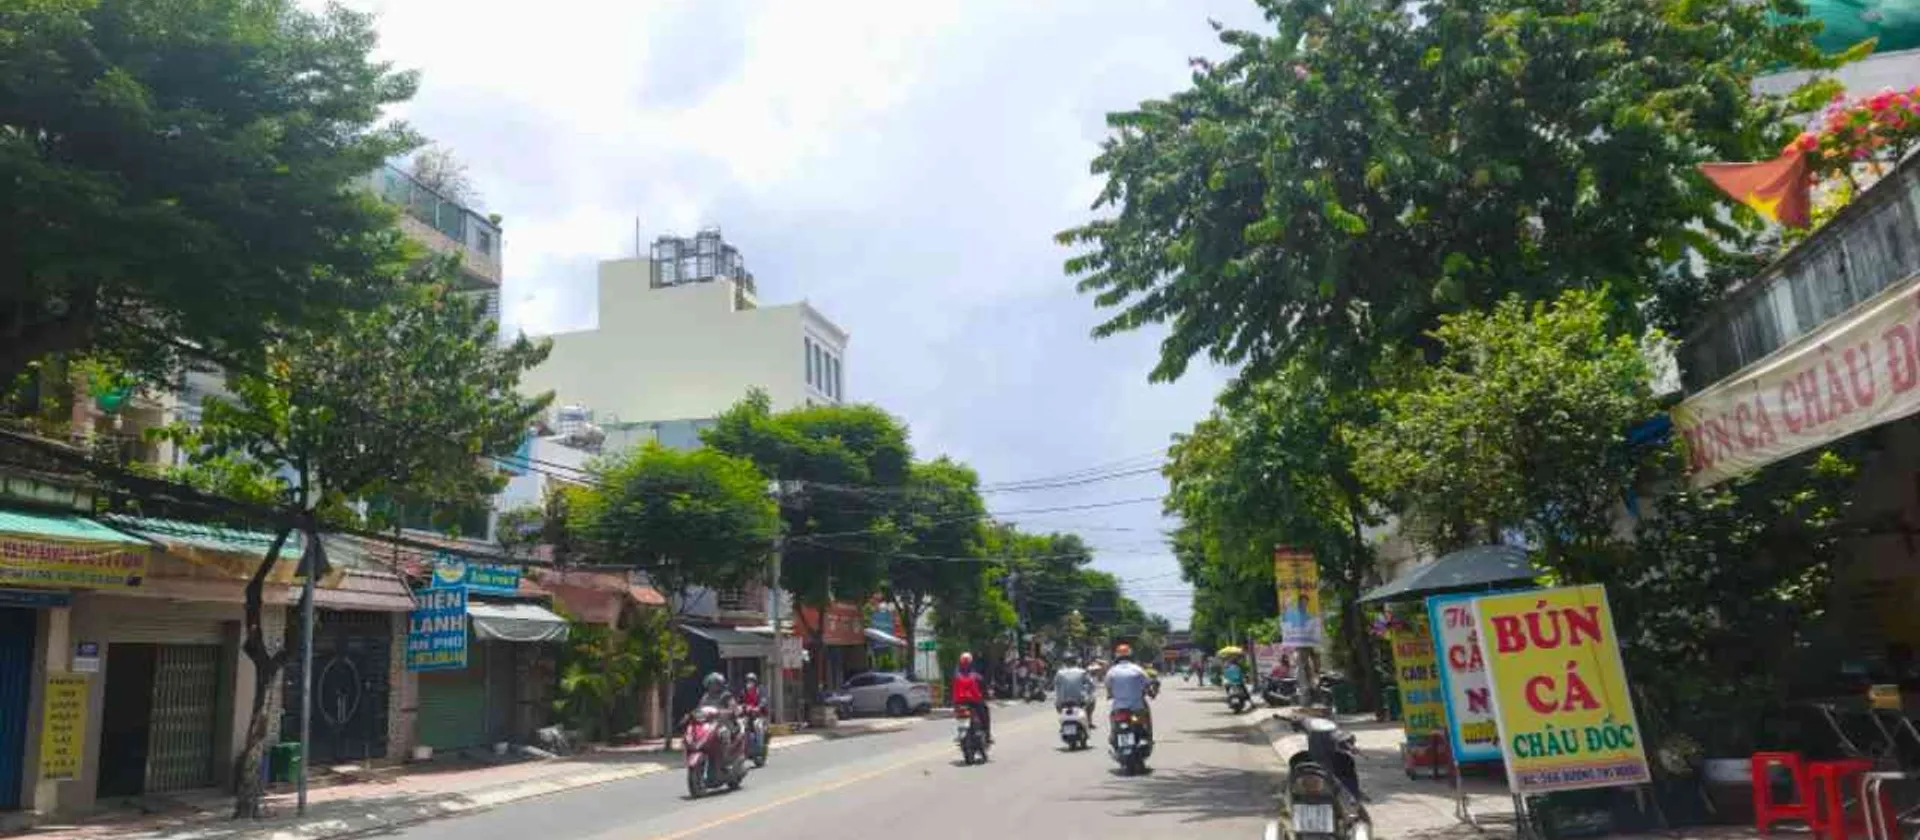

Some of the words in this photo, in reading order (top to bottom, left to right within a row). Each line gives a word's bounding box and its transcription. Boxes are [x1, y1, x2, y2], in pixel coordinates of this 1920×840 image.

[1779, 344, 1875, 433] CHÂU
[1491, 599, 1603, 654] BÚN
[1525, 660, 1601, 714] CÁ
[1513, 724, 1579, 757] CHÂU
[1584, 713, 1635, 751] ĐỐC
